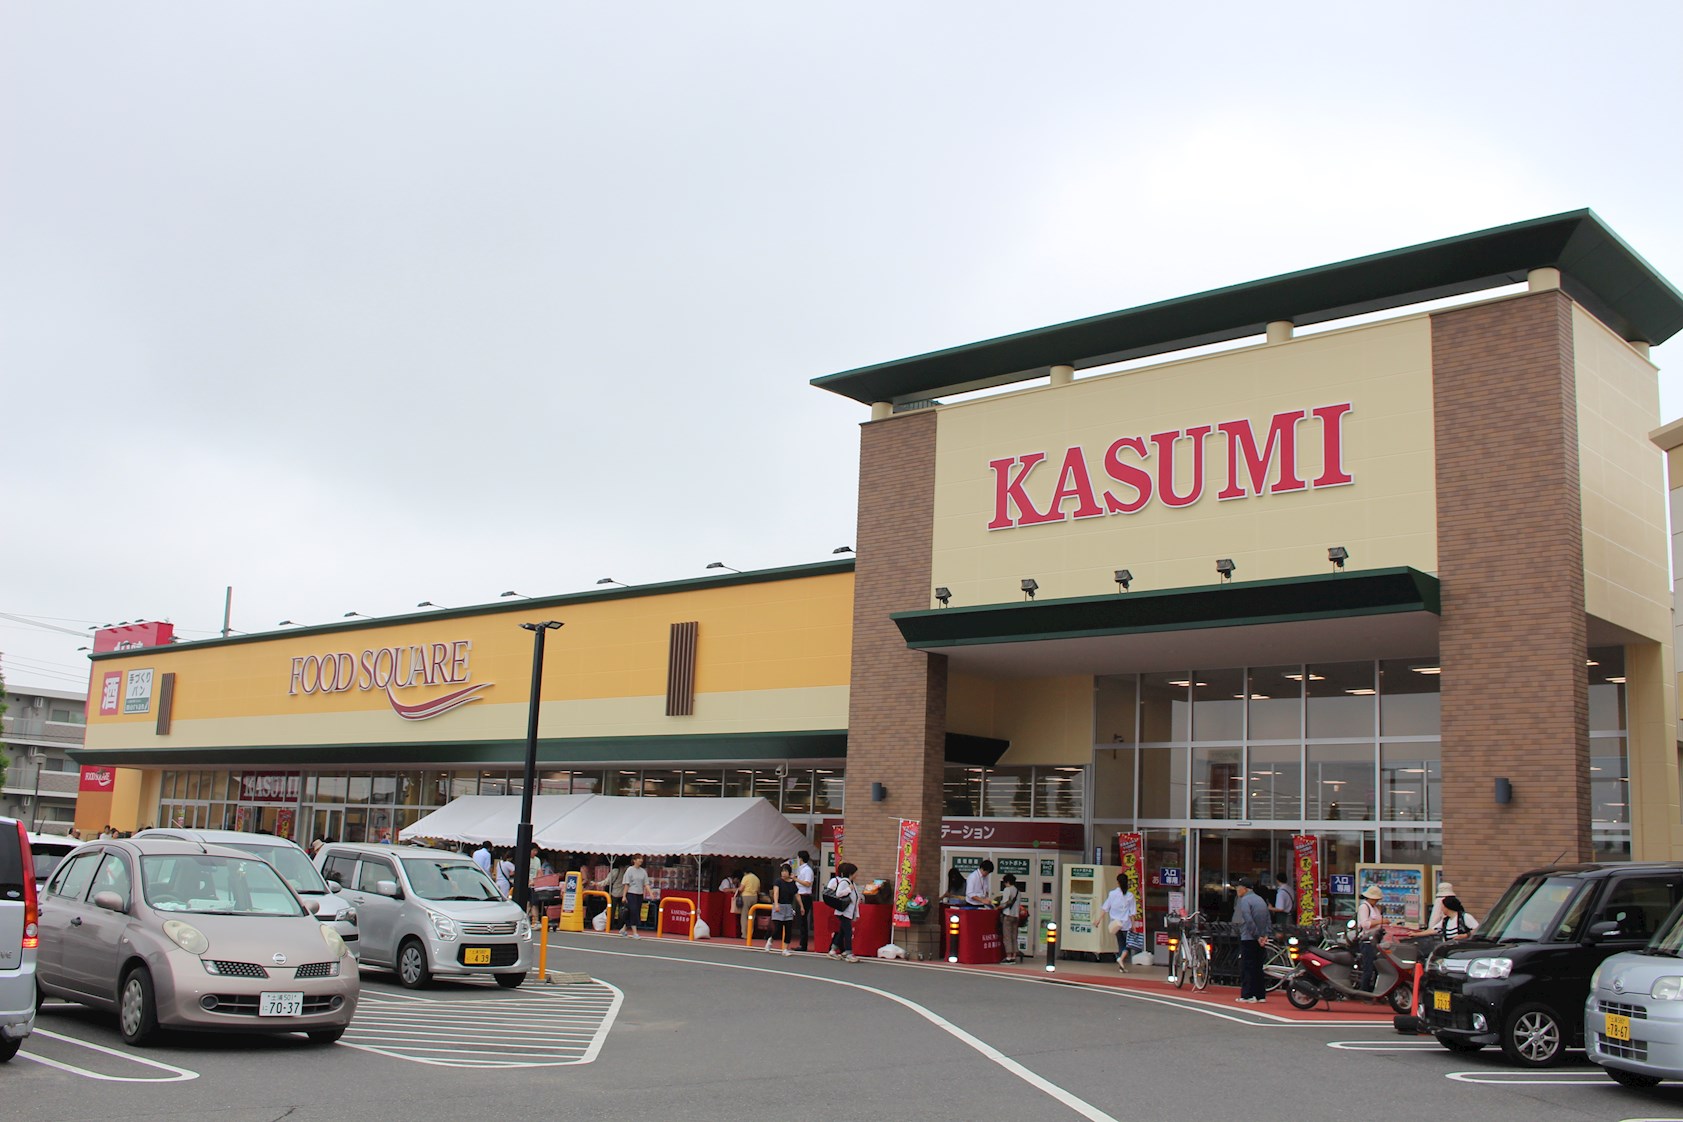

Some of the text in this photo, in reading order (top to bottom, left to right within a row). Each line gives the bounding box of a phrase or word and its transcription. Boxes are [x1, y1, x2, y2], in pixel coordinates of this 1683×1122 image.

[987, 402, 1355, 531] KASUMI
[288, 640, 472, 696] FOOD SQUARE
[129, 672, 151, 684] 手づくり
[102, 677, 120, 709] 酒
[132, 685, 146, 697] パン
[1164, 868, 1177, 877] 入口
[1335, 877, 1349, 885] 入口
[1337, 885, 1351, 893] 専用
[269, 1002, 300, 1014] 70-37
[1610, 1023, 1628, 1039] 78-67
